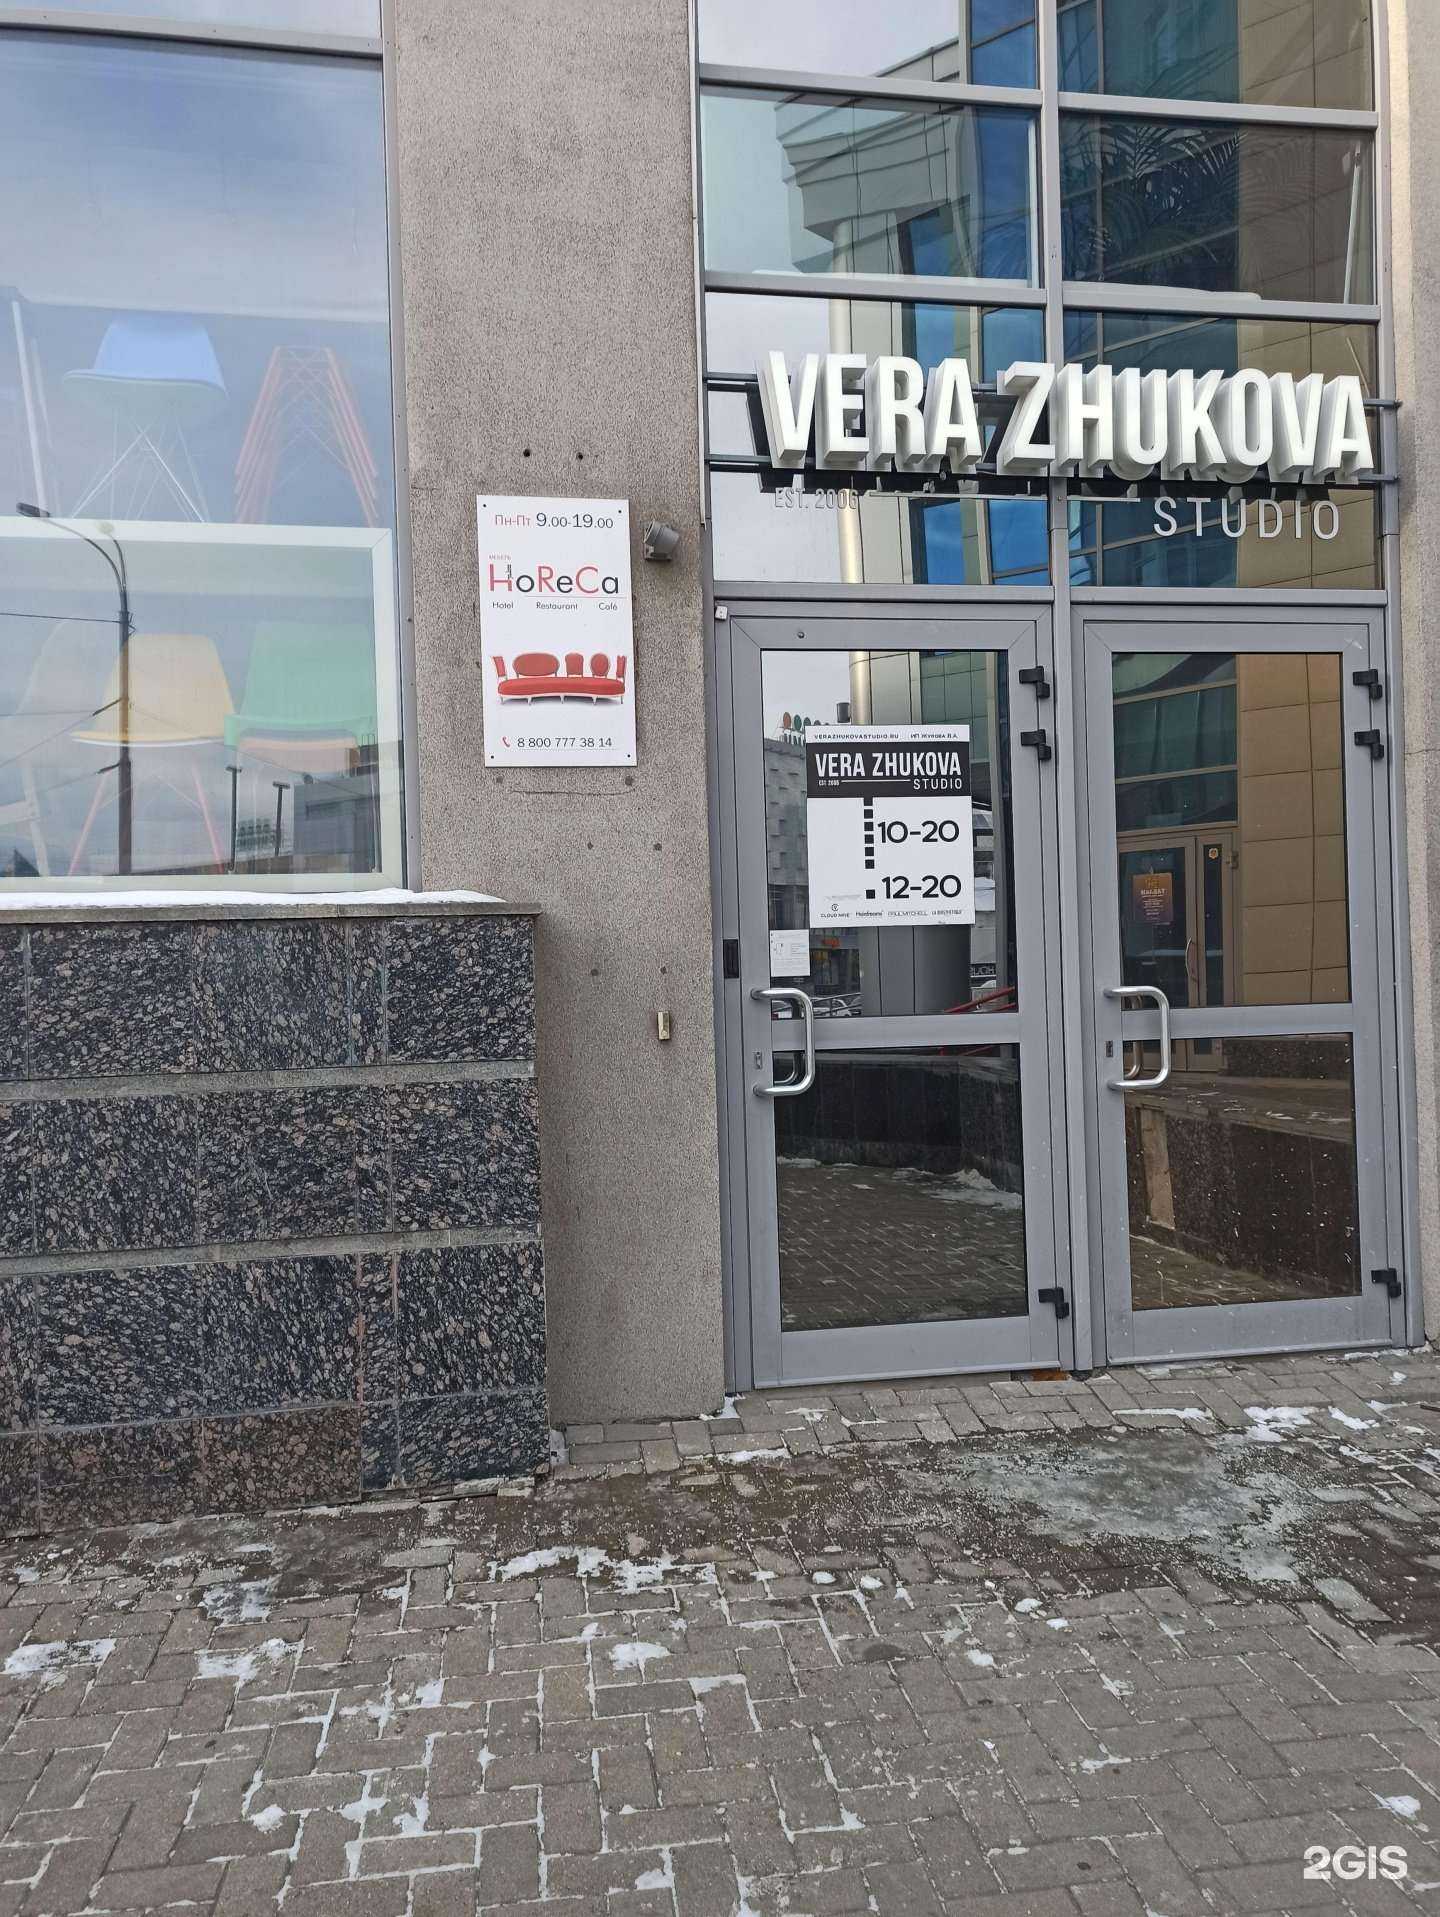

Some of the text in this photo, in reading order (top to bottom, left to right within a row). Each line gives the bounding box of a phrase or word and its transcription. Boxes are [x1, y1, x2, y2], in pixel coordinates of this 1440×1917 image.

[765, 350, 1374, 476] VERA ZHUKOVA
[815, 488, 858, 509] 2006
[536, 512, 614, 529] 9.00-19.00
[1153, 497, 1341, 541] STUDIO
[489, 563, 619, 595] HoReCa
[492, 601, 514, 609] Hotel
[536, 601, 578, 611] Restaurant
[517, 737, 612, 748] 8 800 777 38 14
[815, 751, 962, 777] VERA ZHUKOVA
[913, 778, 963, 790] STUDIO
[877, 819, 960, 844] 10-20
[881, 874, 962, 899] 12-20
